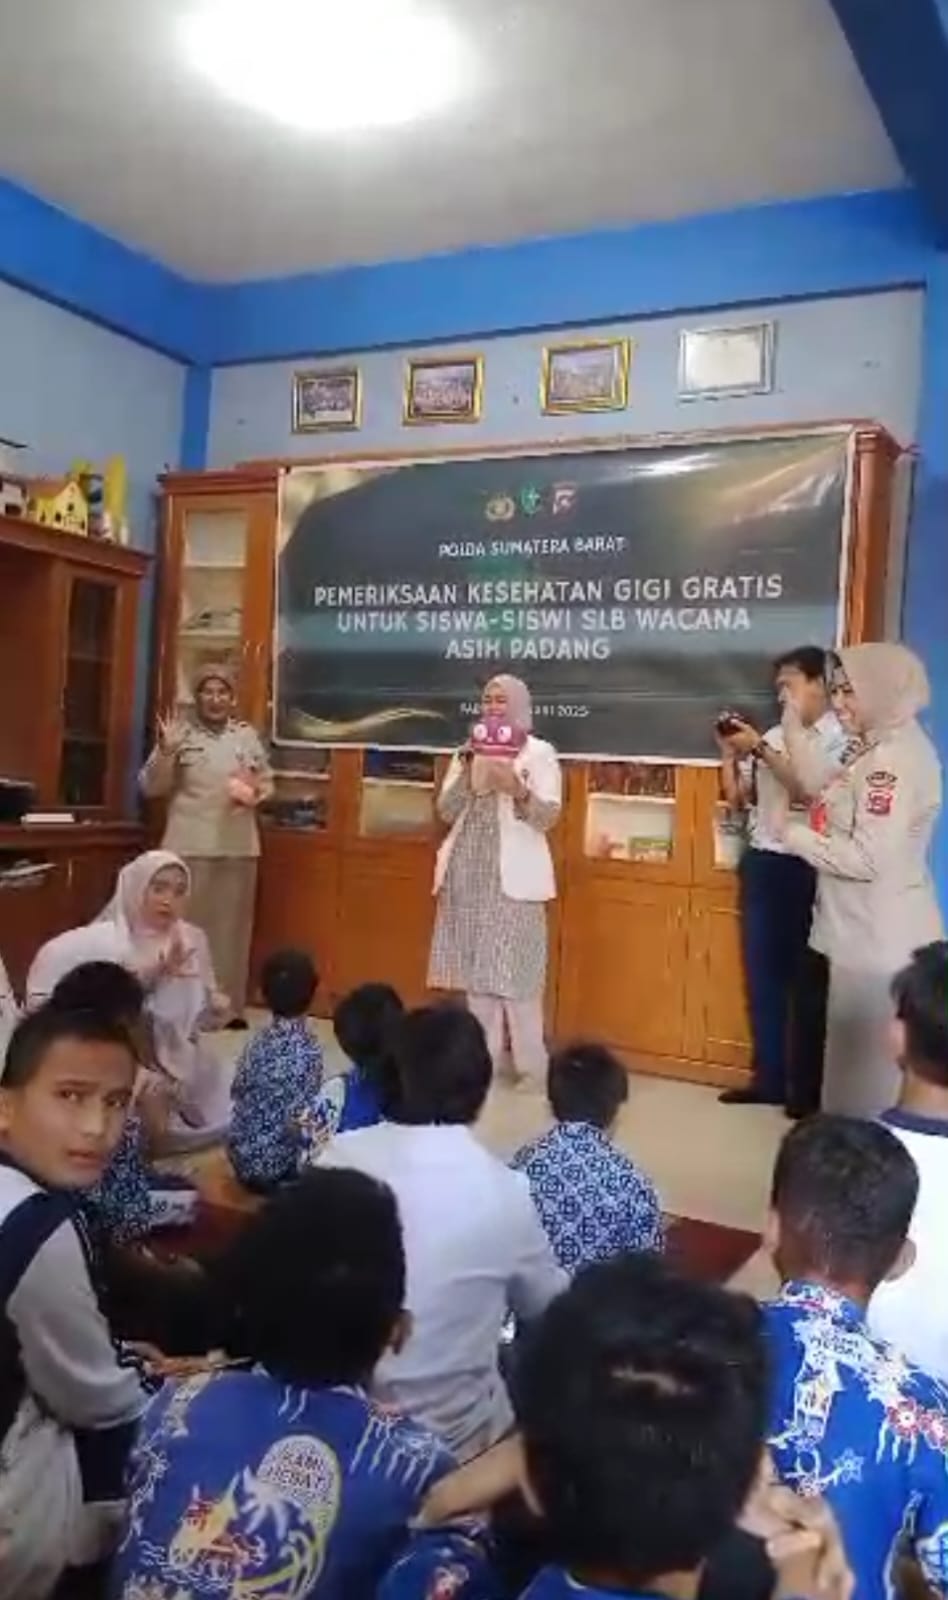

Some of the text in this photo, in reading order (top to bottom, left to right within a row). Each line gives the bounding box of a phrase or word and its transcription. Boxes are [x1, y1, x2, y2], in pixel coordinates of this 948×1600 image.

[438, 536, 626, 557] POLDA SUMATERA BARAT
[314, 573, 783, 607] PEMERIKSAAN KESEHATAN GIGI GRATIS
[337, 607, 751, 634] UNTUK SISWA-SISWI SLB WACANA
[445, 636, 610, 660] ASIH PADANG
